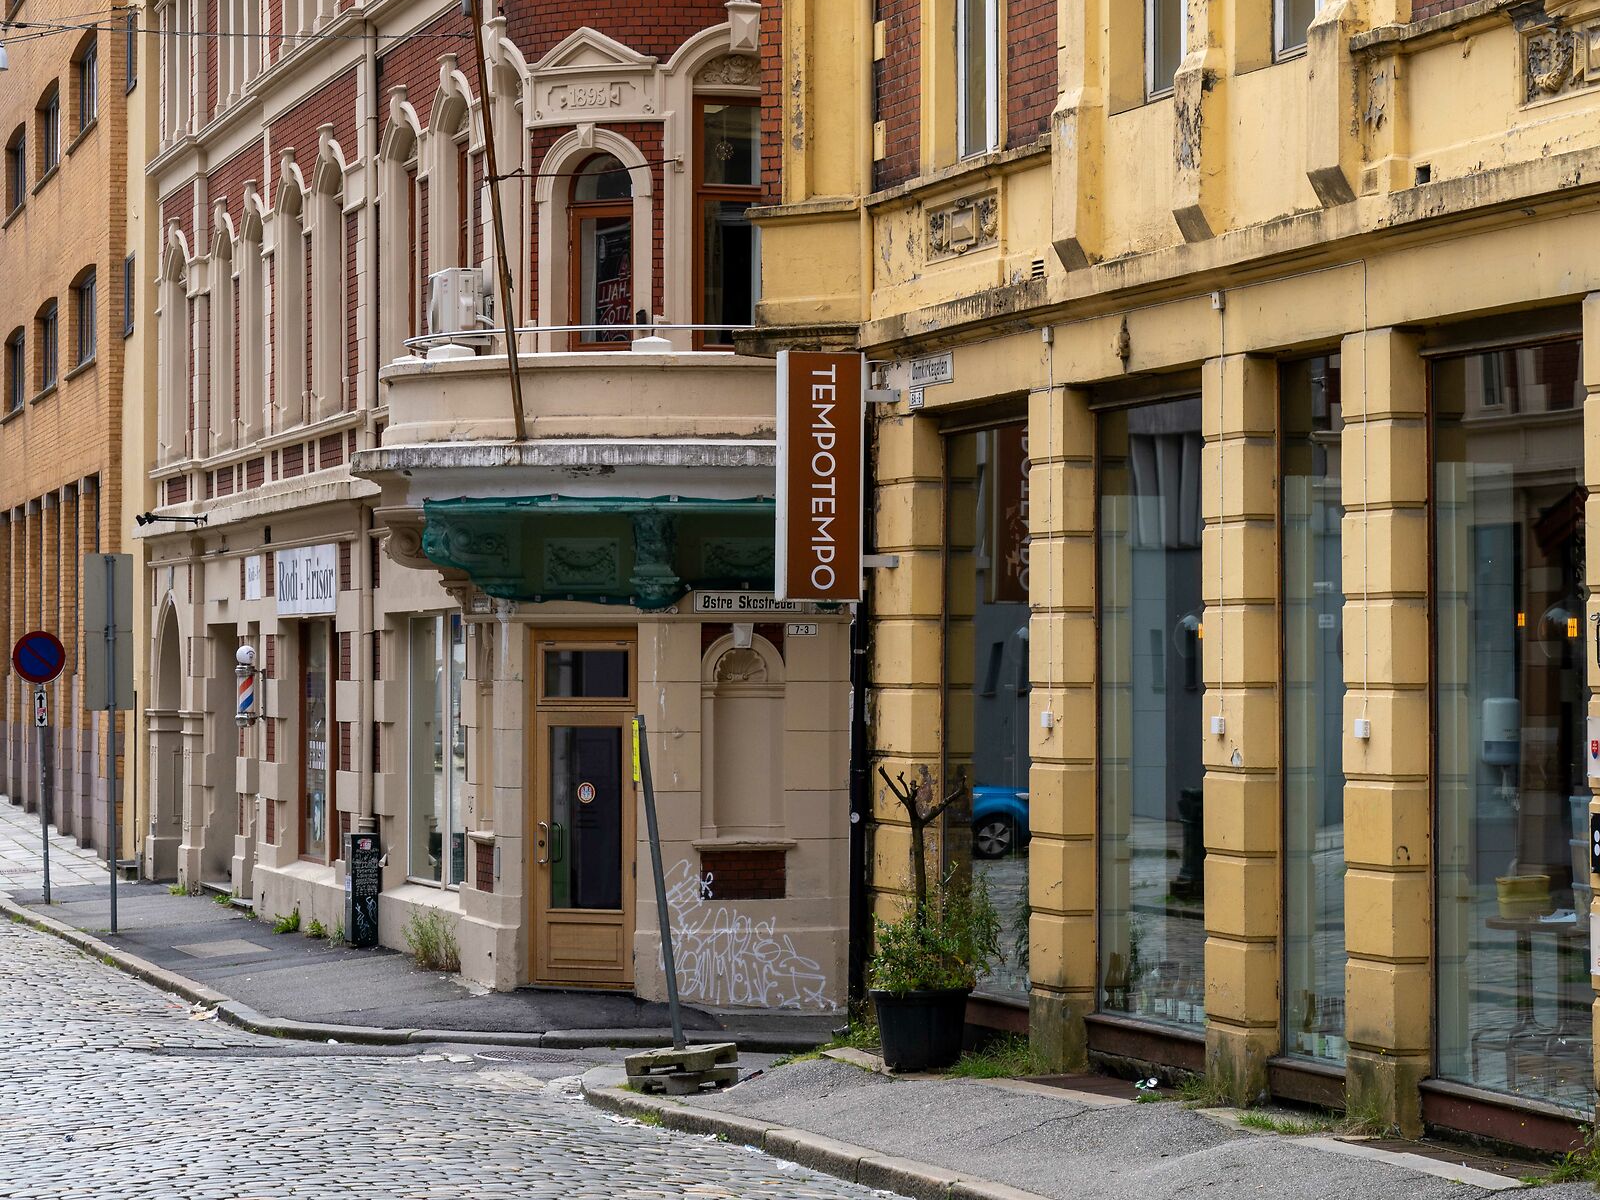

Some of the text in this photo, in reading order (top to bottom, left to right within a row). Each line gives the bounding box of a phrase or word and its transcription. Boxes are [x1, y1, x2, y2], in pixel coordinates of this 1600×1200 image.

[570, 87, 606, 108] 1895
[811, 364, 836, 590] TEMPOTEMPO
[278, 558, 298, 602] Rodi
[305, 557, 333, 604] Frisør
[703, 595, 733, 609] Østre
[795, 625, 809, 634] 7-3
